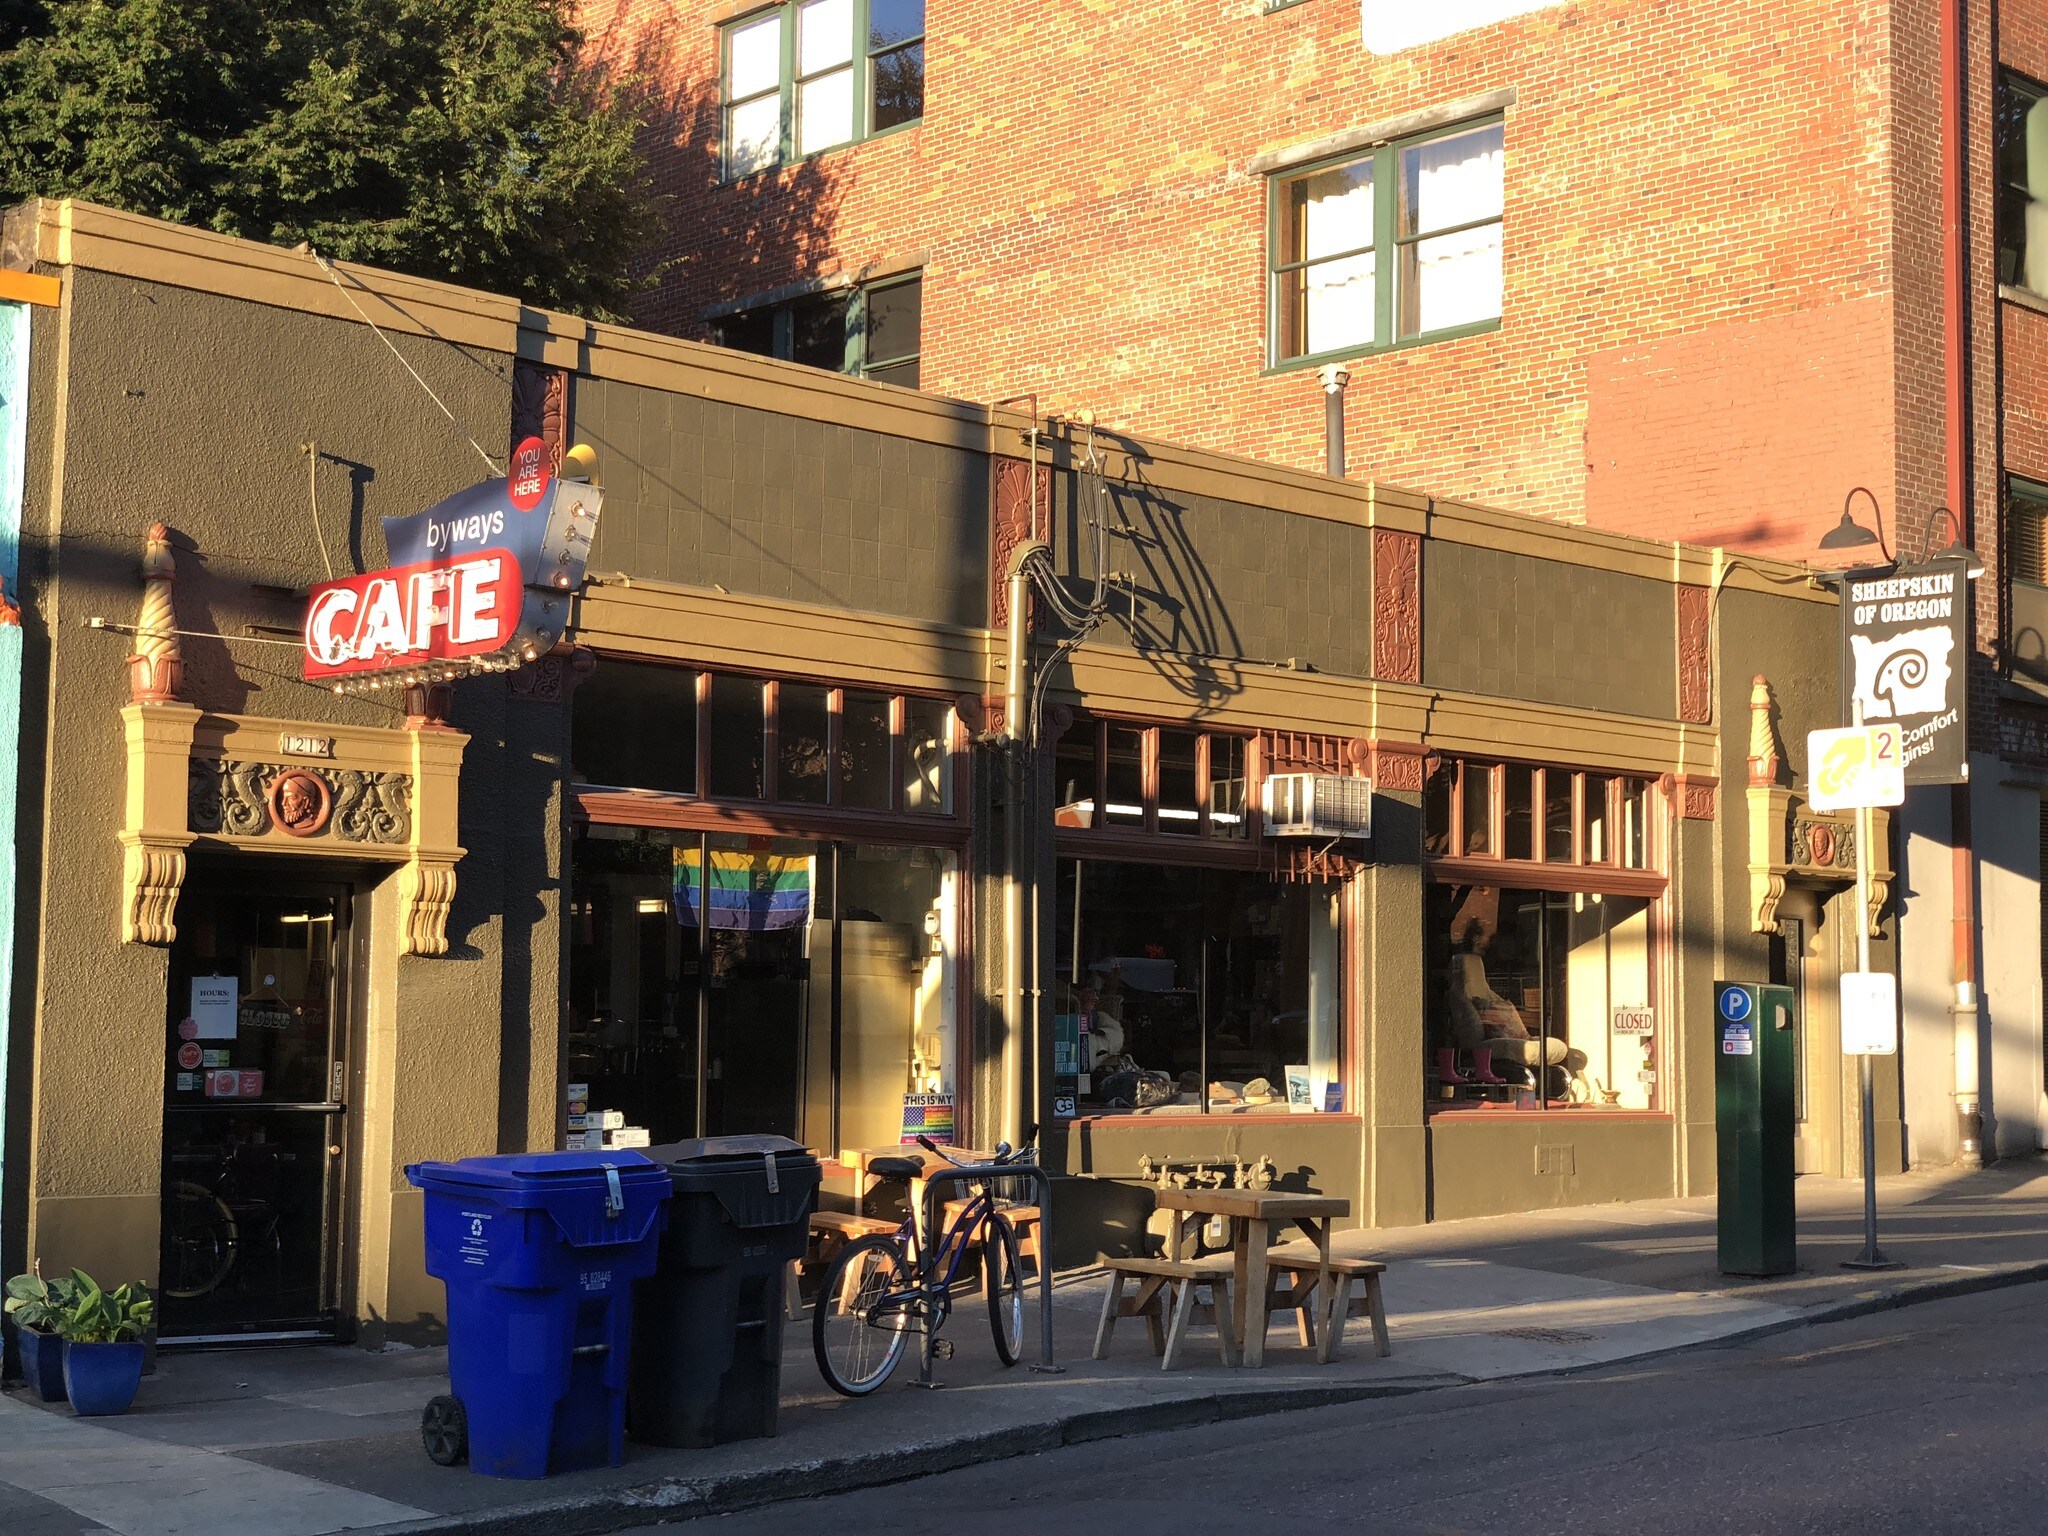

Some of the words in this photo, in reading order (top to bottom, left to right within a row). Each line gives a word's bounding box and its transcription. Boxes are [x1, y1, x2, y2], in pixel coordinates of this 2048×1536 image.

[519, 447, 540, 464] YOU
[518, 463, 539, 480] ARE
[514, 478, 541, 497] HERE
[426, 510, 505, 552] byways
[1851, 574, 1955, 603] SHEEPSKIN
[305, 557, 501, 667] CAFE
[1854, 605, 1877, 625] OF
[1881, 598, 1953, 623] OREGON
[1901, 708, 1958, 746] Comfort
[286, 736, 328, 753] 1212
[1877, 731, 1893, 760] 2
[1902, 736, 1934, 768] gins!
[1729, 993, 1743, 1015] P
[1615, 1013, 1652, 1029] CLOSED
[905, 1095, 926, 1106] THIS
[927, 1095, 935, 1105] IS
[937, 1094, 952, 1105] MY
